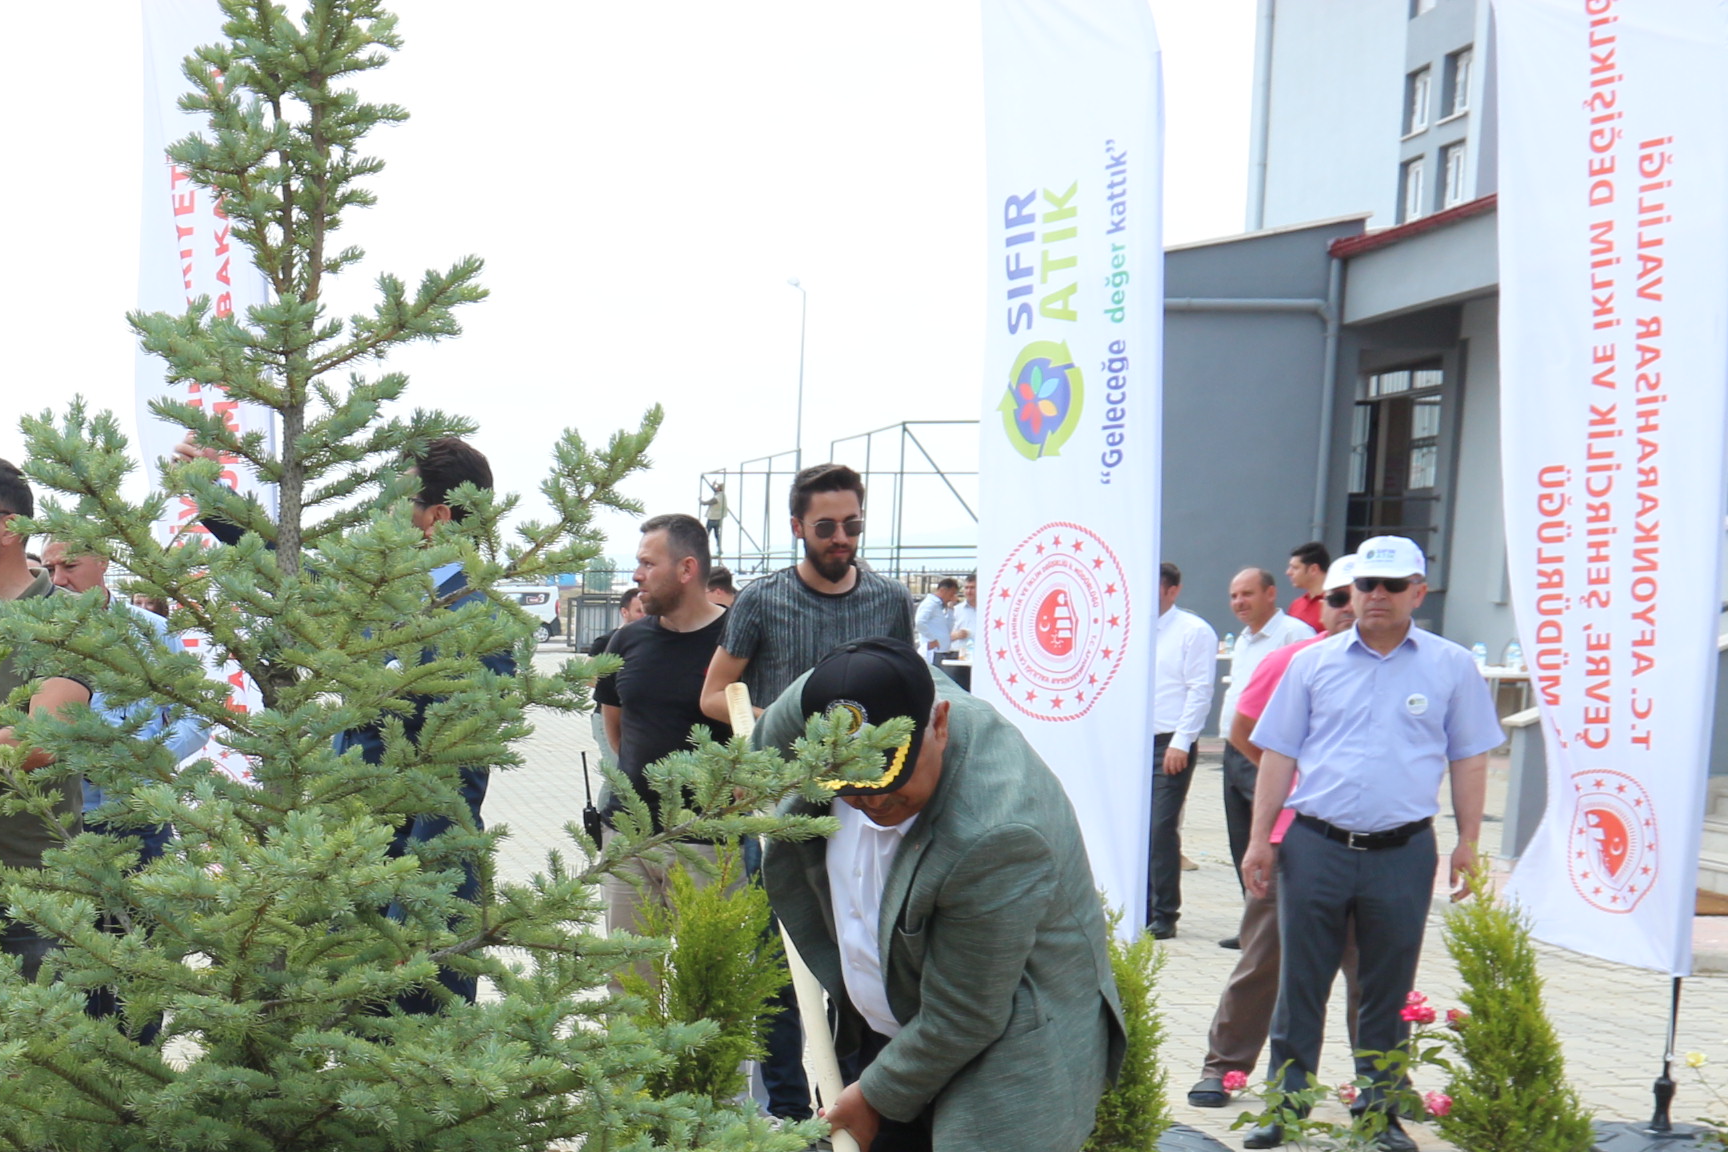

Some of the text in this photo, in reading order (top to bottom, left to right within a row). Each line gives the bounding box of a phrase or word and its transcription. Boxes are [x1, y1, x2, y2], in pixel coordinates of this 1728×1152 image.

[1003, 190, 1037, 336] SIFIR
[1040, 182, 1078, 322] ATIK
[1102, 242, 1130, 325] değer
